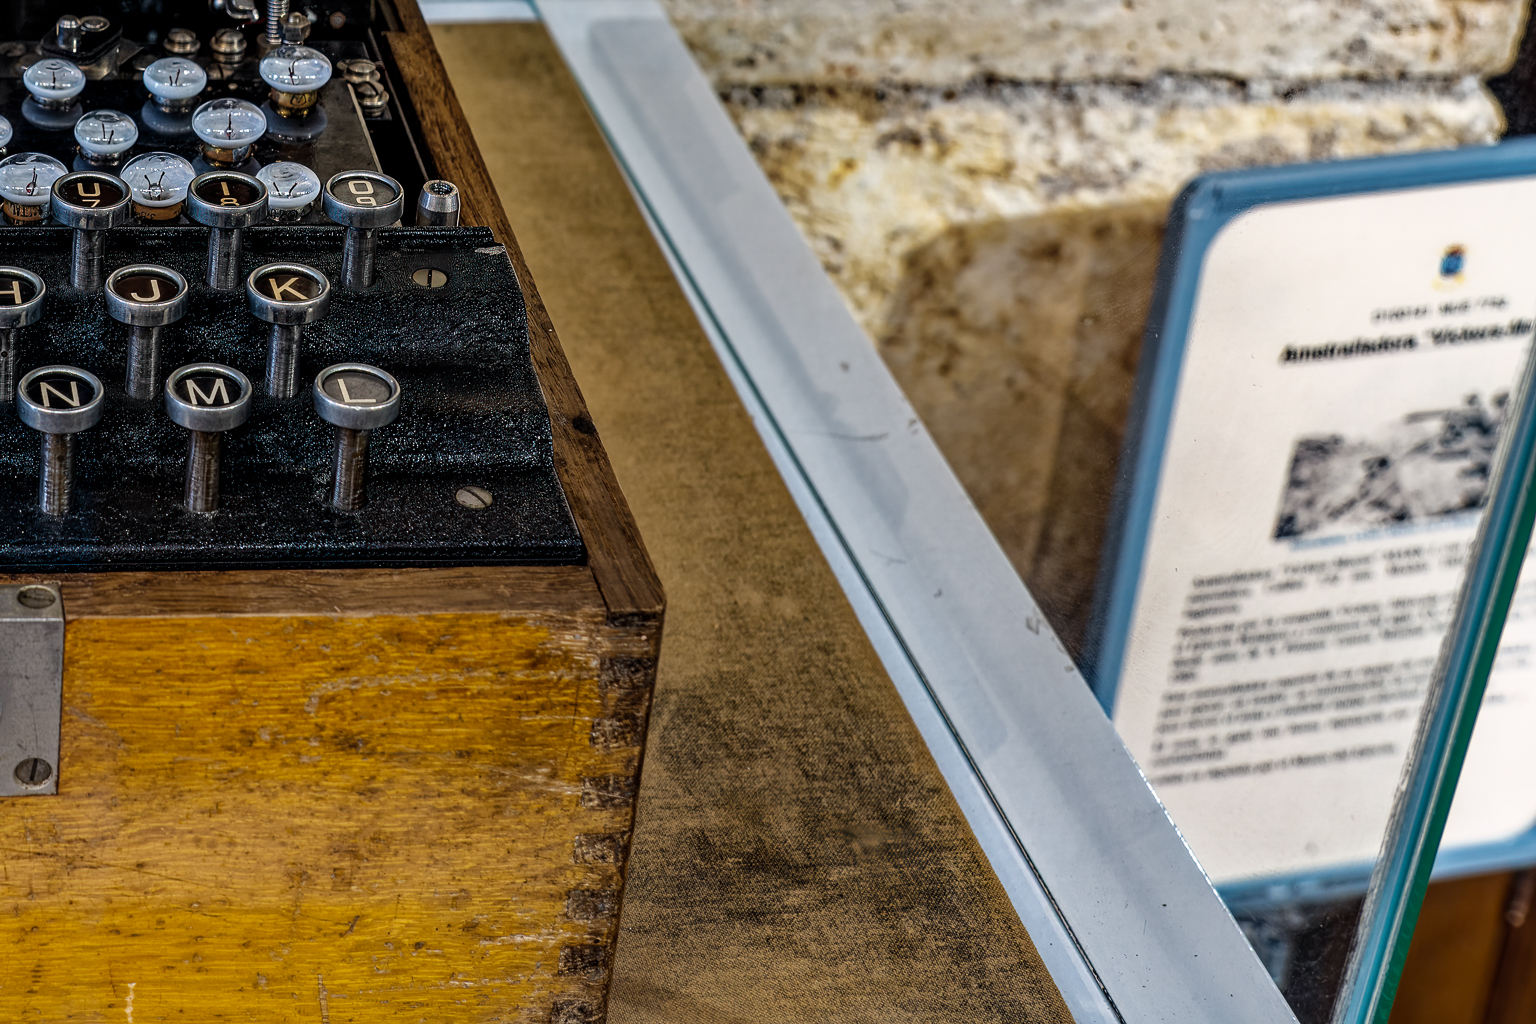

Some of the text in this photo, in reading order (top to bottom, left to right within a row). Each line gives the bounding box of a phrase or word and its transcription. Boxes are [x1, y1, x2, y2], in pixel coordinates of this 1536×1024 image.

[77, 182, 101, 197] U
[220, 181, 230, 196] I
[347, 180, 374, 195] O
[130, 279, 161, 302] J
[268, 277, 306, 301] K
[39, 381, 80, 408] N
[185, 378, 227, 405] M
[337, 378, 377, 403] L
